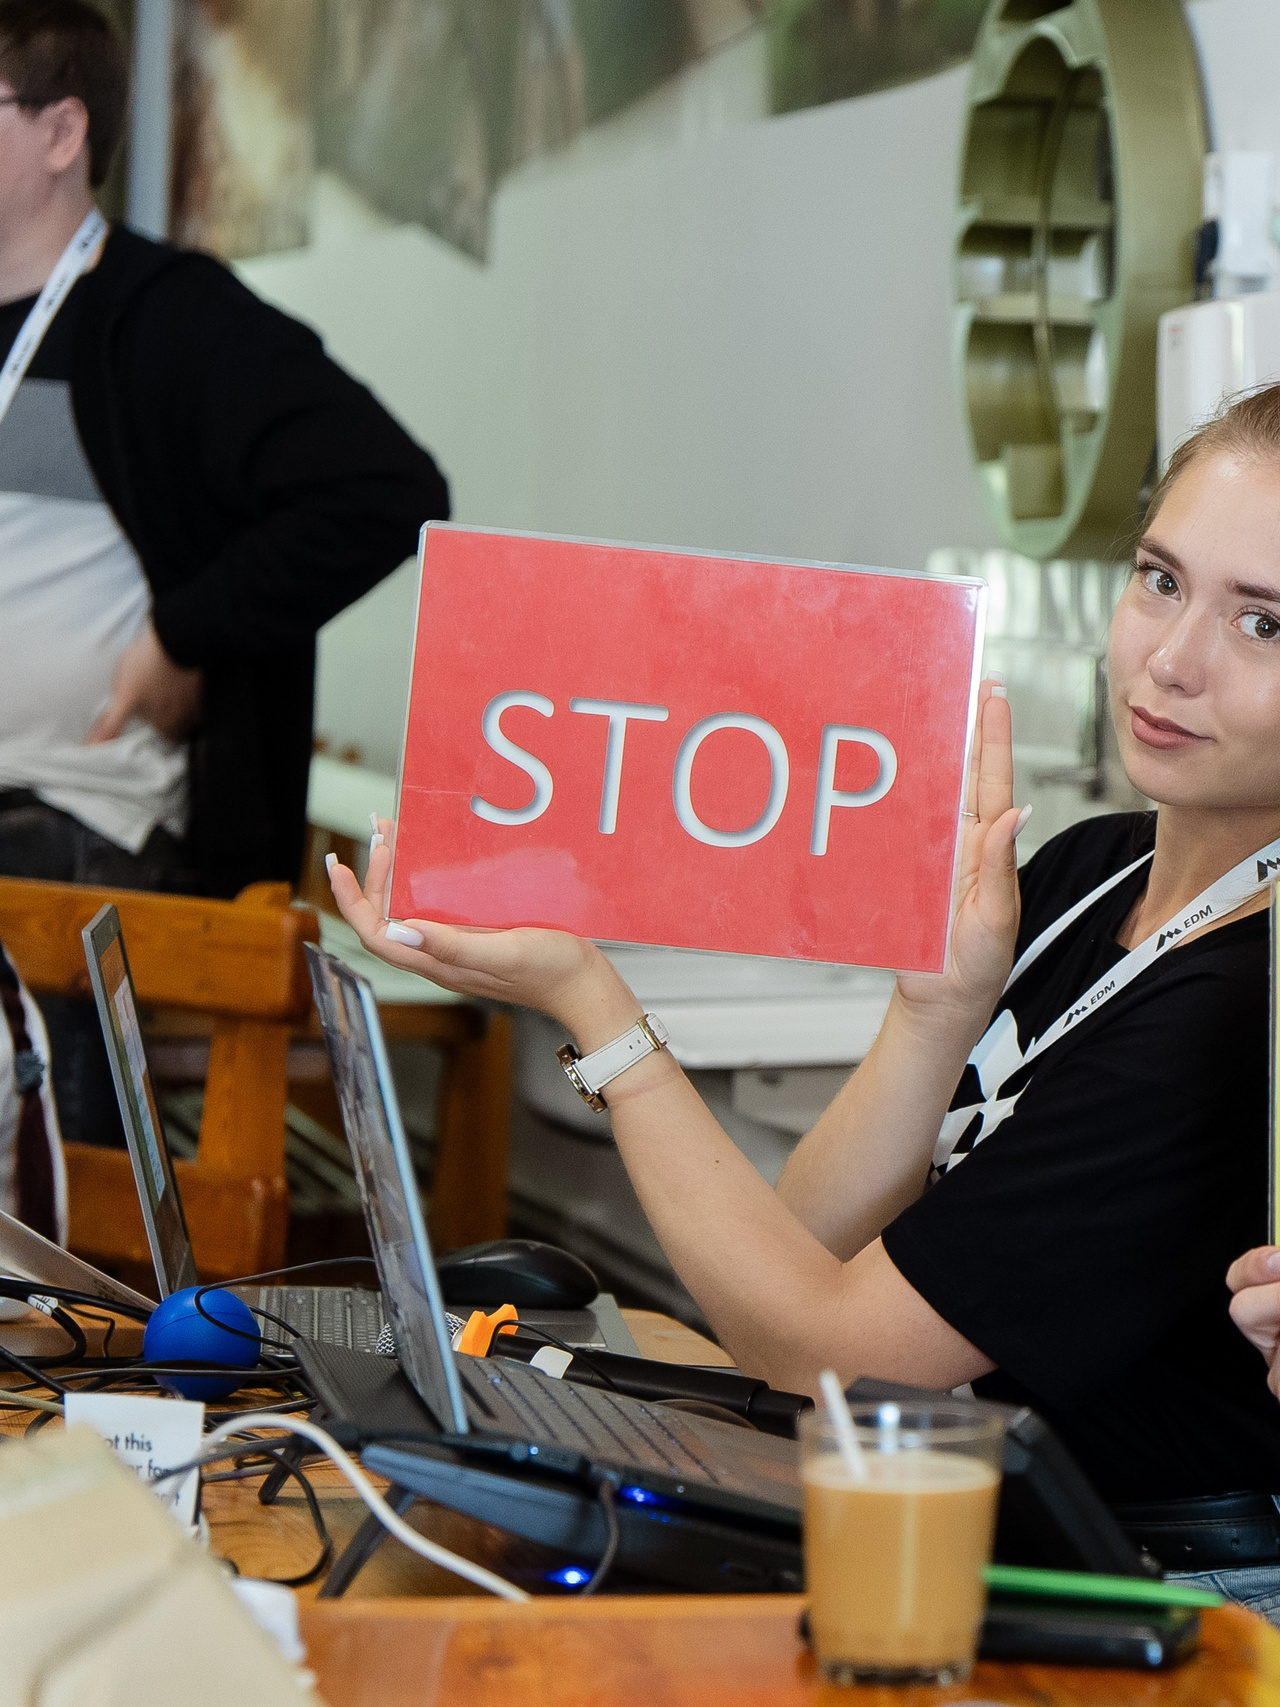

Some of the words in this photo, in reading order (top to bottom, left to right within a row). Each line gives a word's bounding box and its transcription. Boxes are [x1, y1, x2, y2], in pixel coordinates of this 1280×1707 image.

[470, 689, 898, 856] STOP
[1183, 904, 1213, 929] EDM
[1090, 980, 1116, 1005] EDM
[125, 1432, 152, 1452] this
